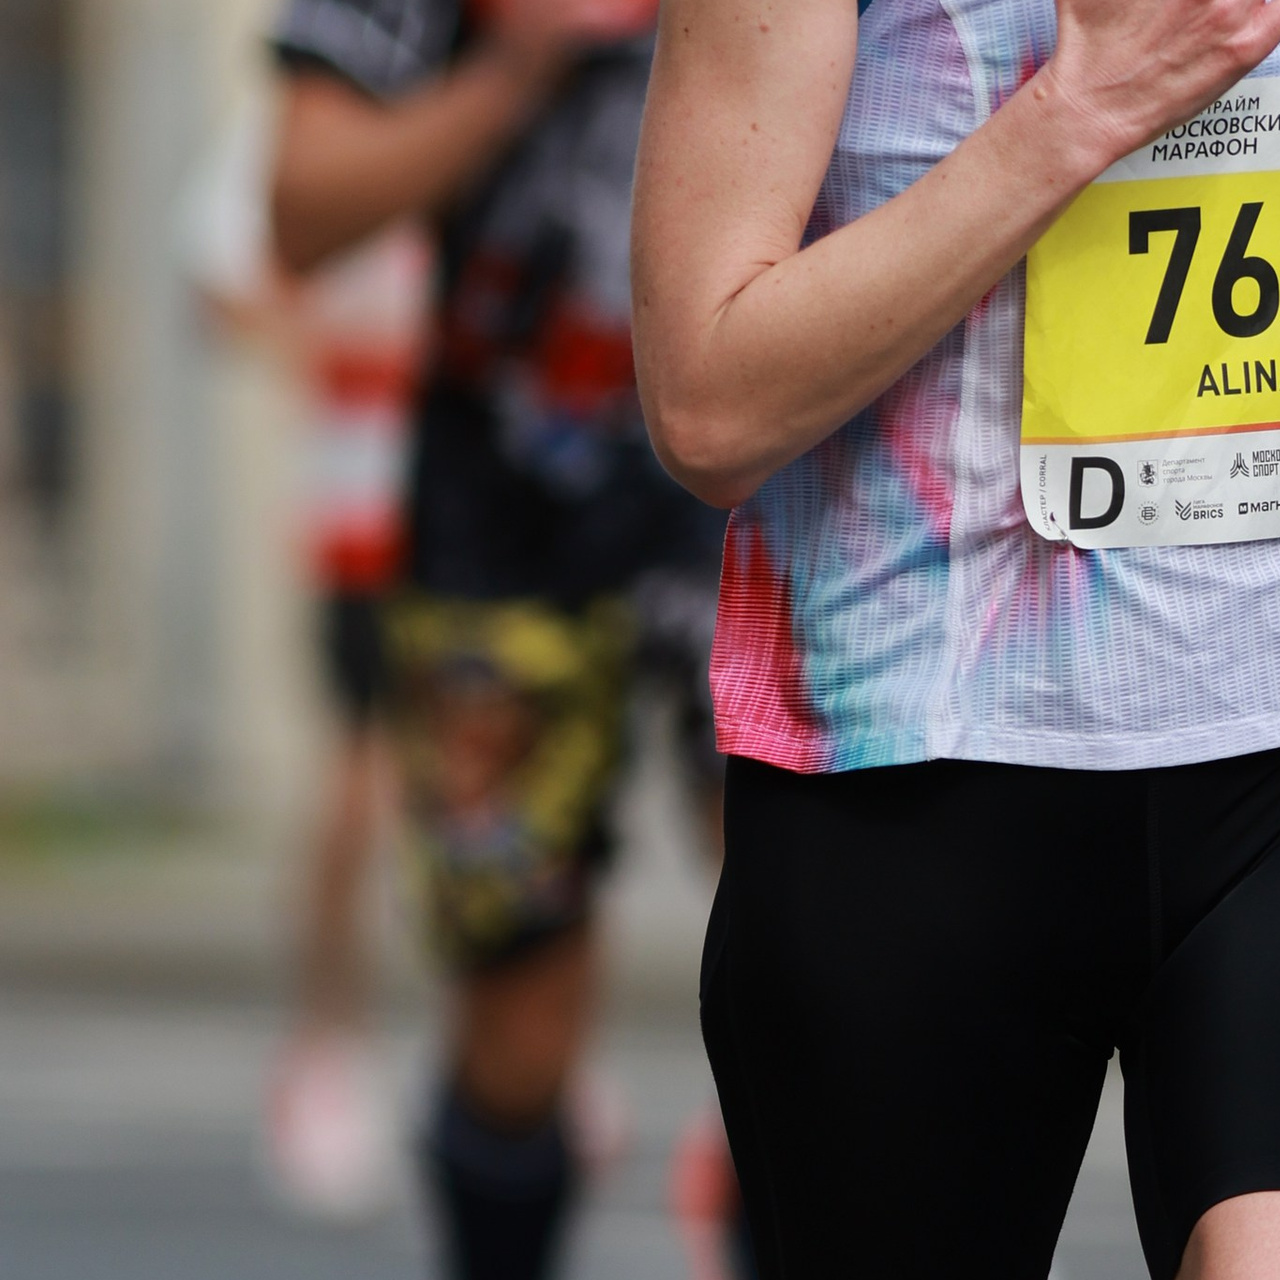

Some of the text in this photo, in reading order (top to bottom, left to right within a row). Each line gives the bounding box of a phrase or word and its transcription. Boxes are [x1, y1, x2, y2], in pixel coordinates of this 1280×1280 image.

[1151, 137, 1258, 162] МАРАФОН
[1038, 454, 1047, 488] CORRAL
[1252, 463, 1279, 477] СПОРТ
[1069, 456, 1126, 530] D
[1193, 509, 1224, 520] BRICS
